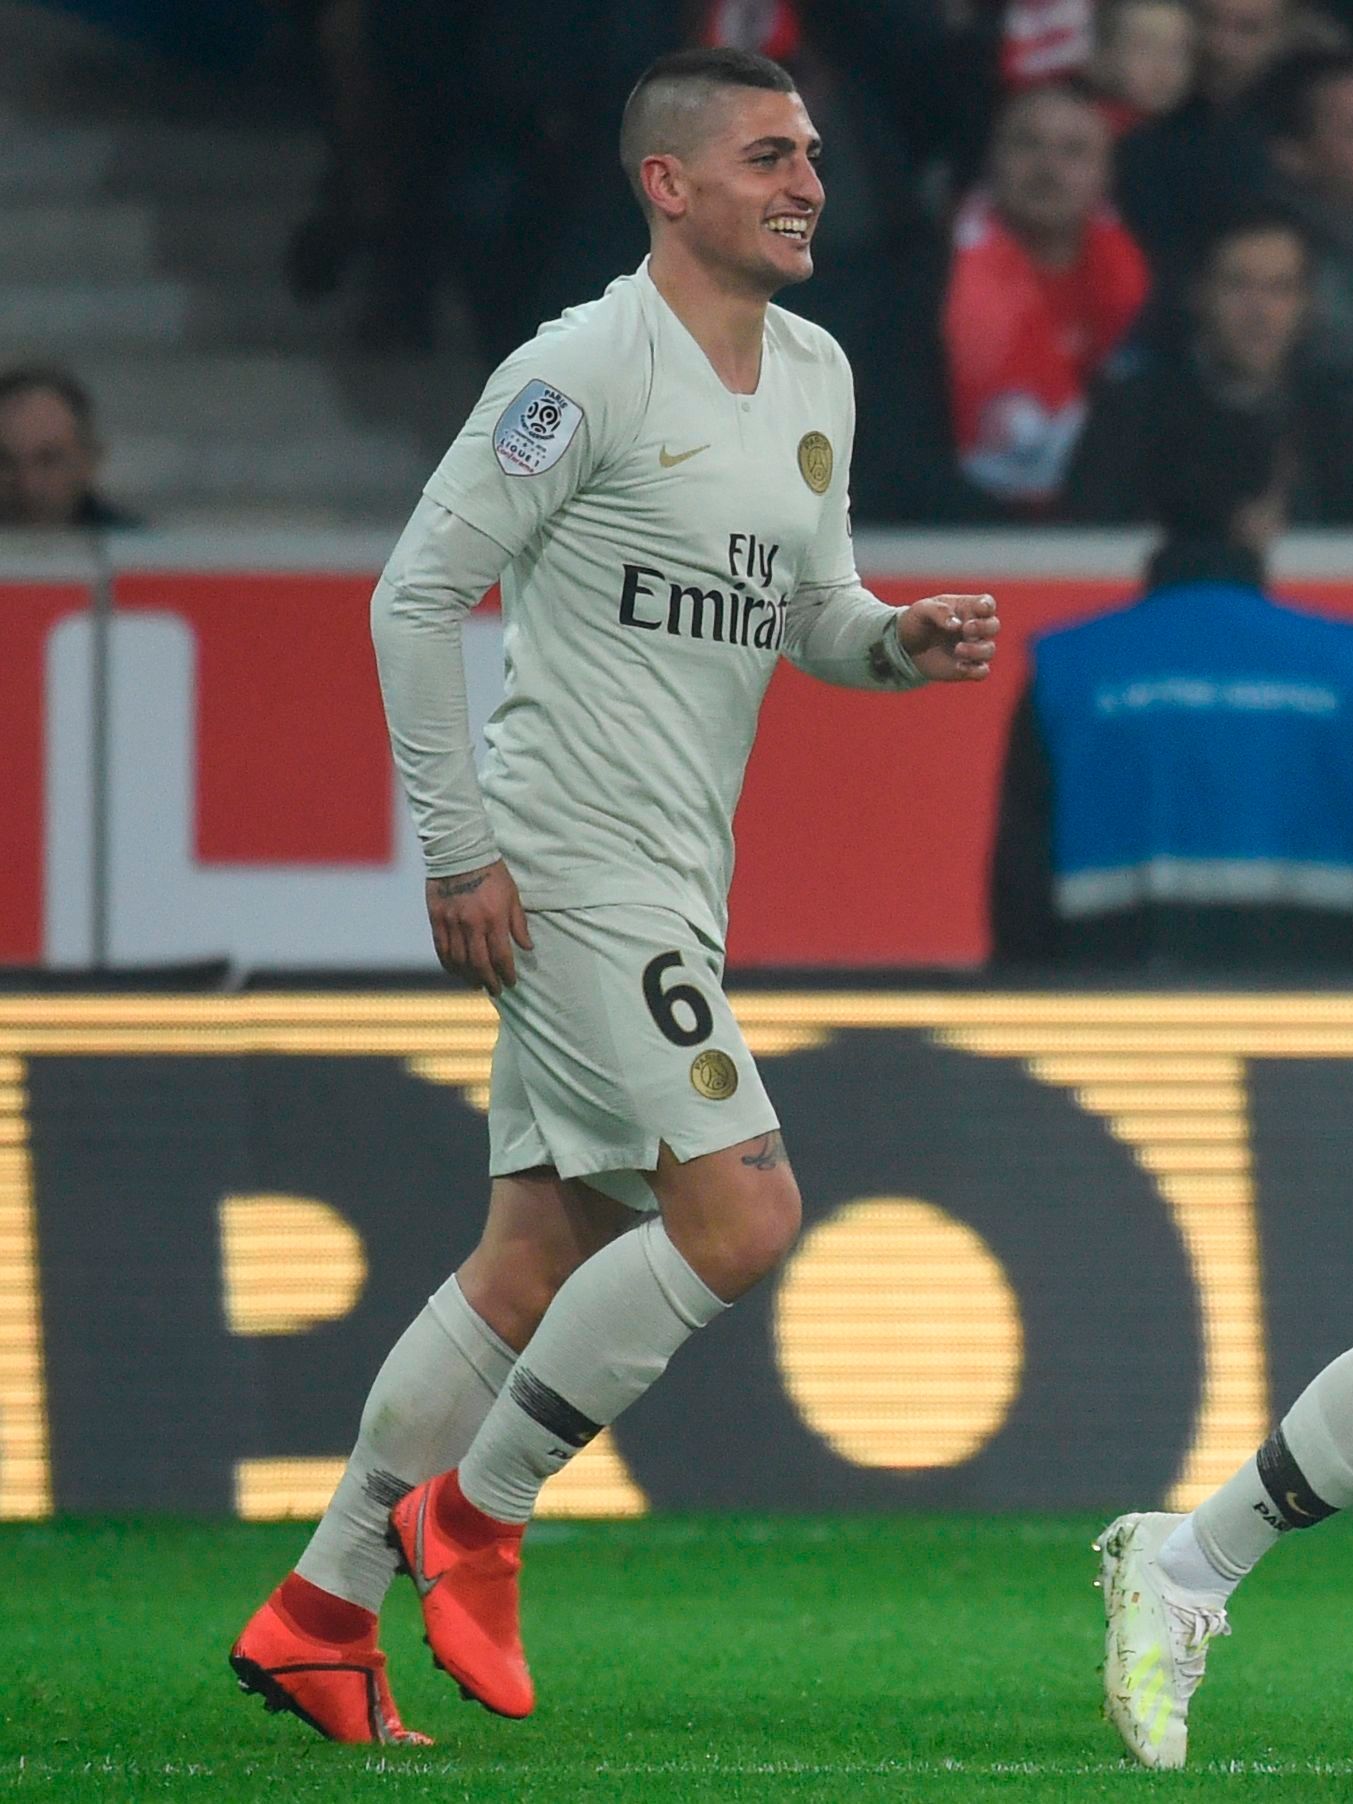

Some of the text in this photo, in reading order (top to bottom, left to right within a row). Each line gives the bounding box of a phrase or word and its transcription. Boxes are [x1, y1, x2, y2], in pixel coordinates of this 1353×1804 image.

[728, 533, 780, 588] Fly
[619, 563, 791, 651] Emirat
[642, 949, 714, 1047] 6
